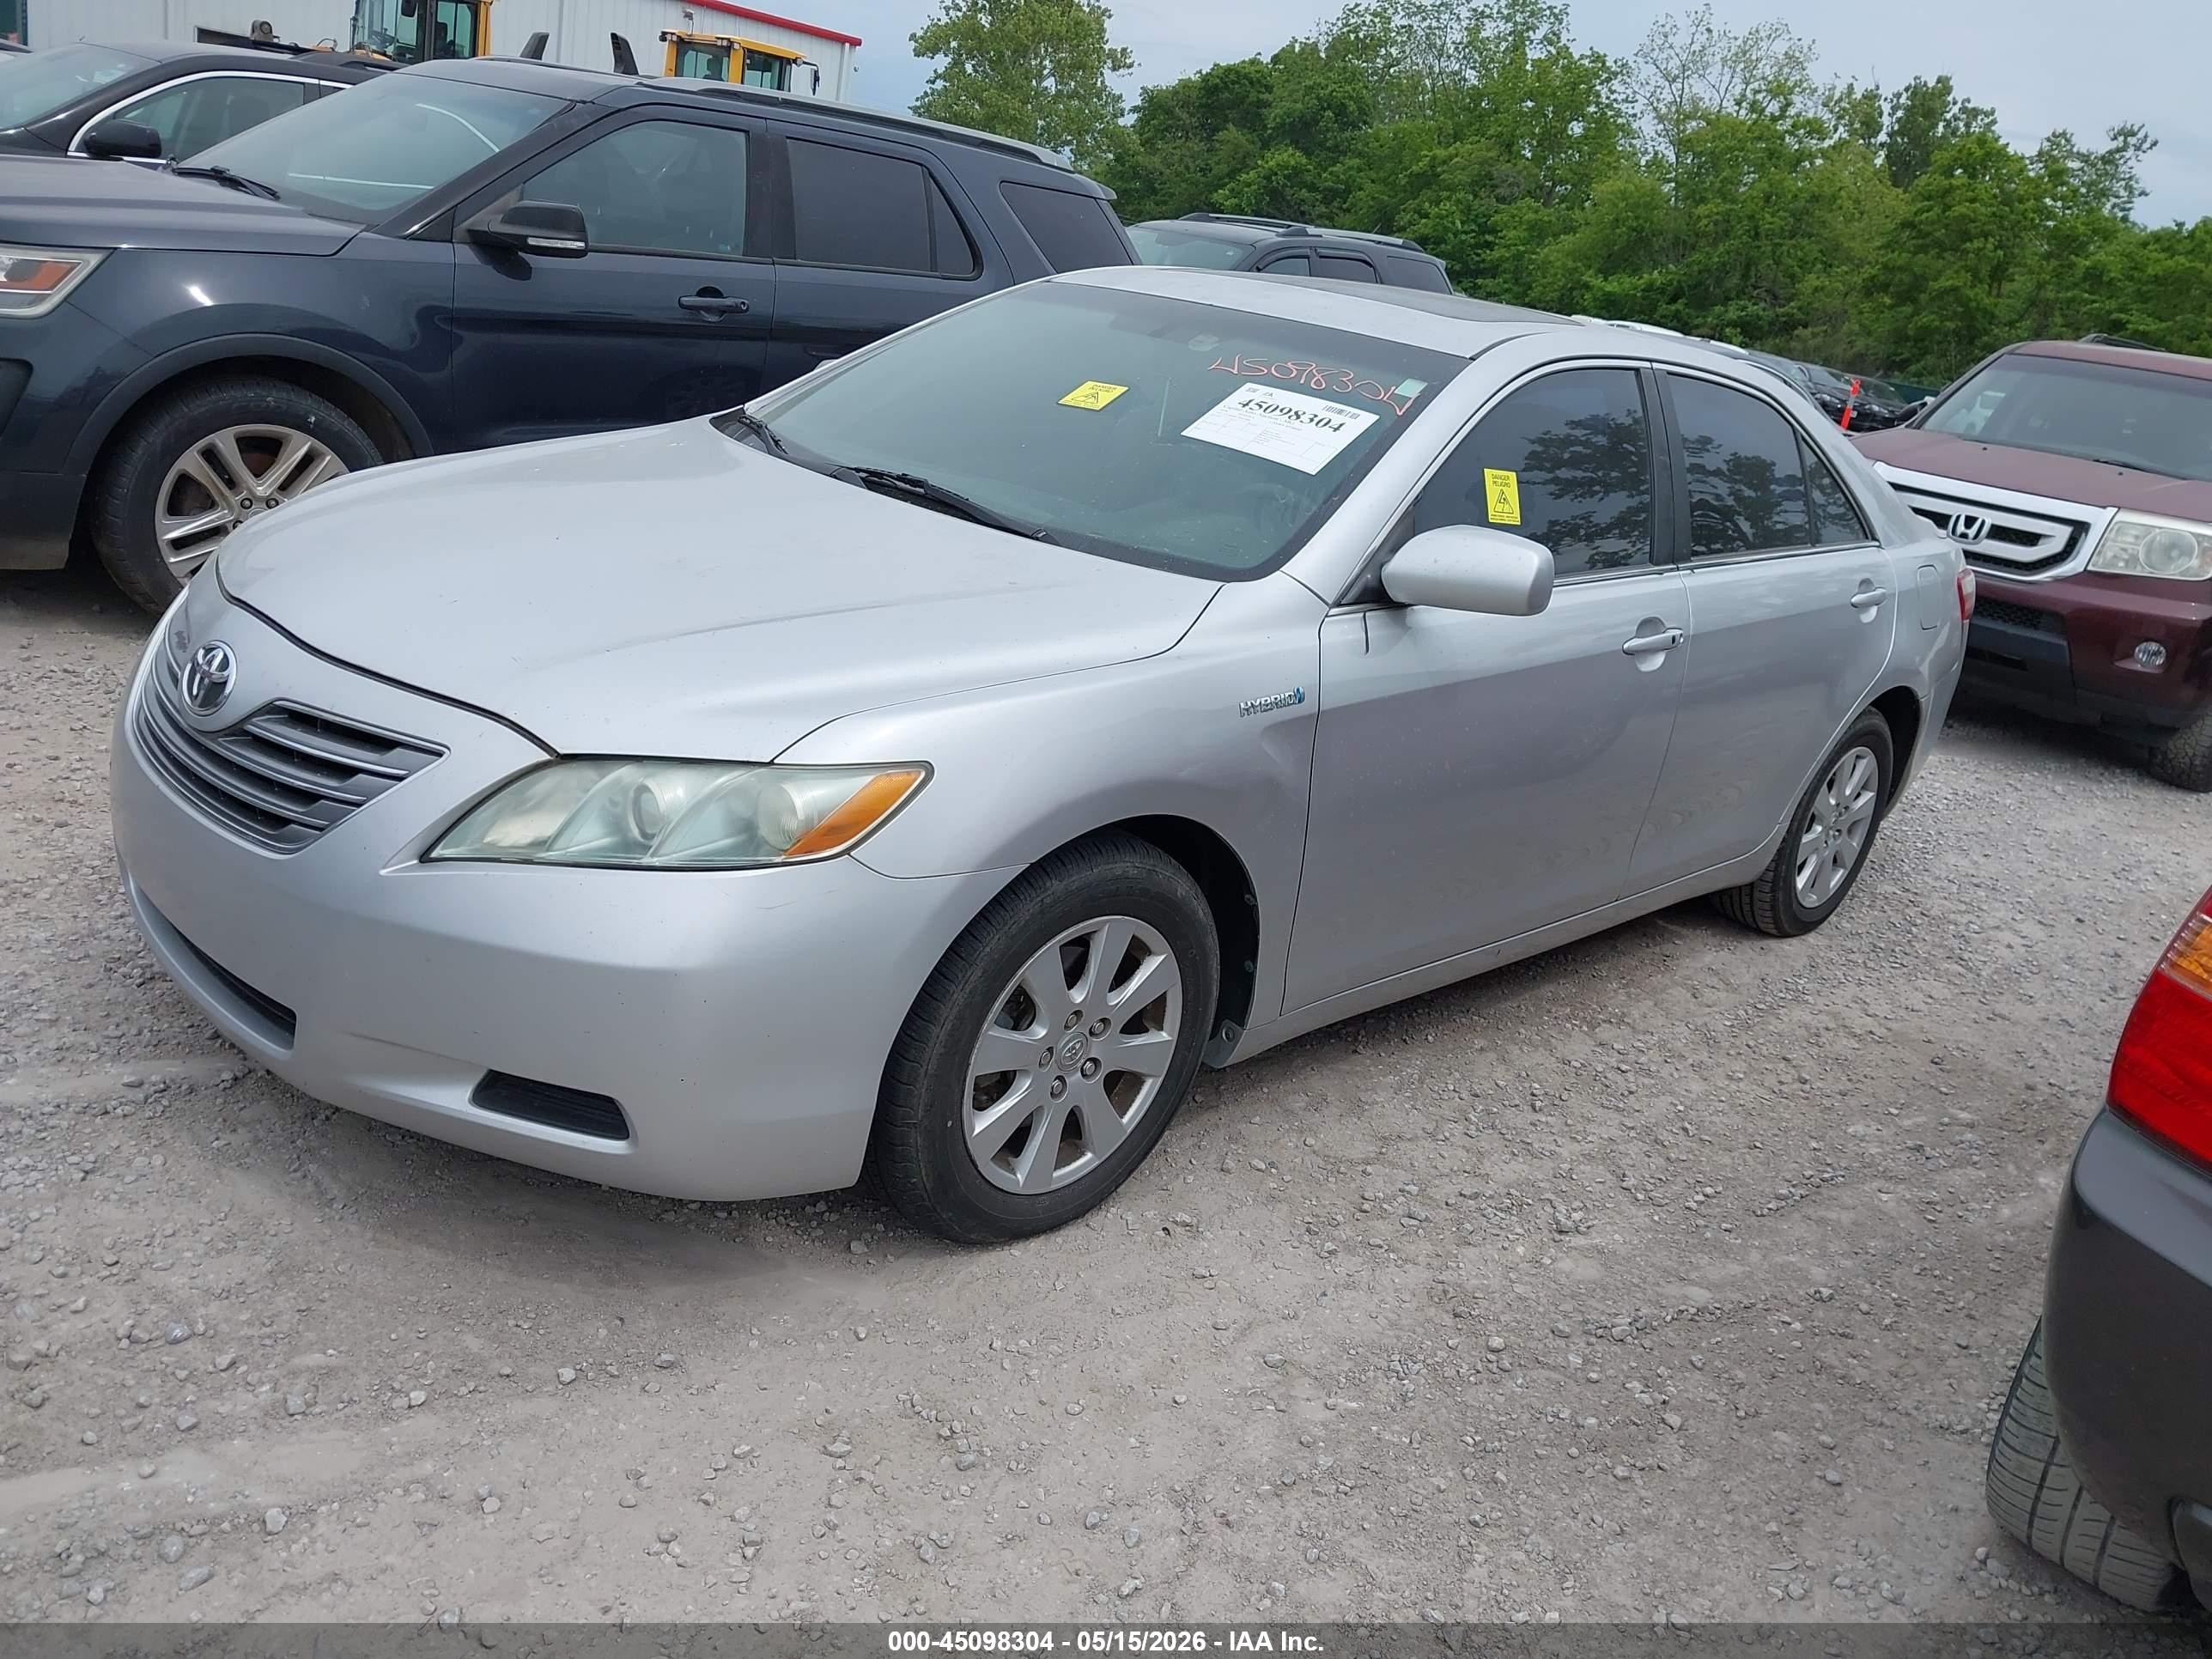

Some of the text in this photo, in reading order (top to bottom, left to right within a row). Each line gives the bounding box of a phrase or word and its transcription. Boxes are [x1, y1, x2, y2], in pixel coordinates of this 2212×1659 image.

[1208, 354, 1420, 416] 45098304
[1237, 398, 1346, 433] 45098304
[1239, 692, 1295, 716] HYBRID
